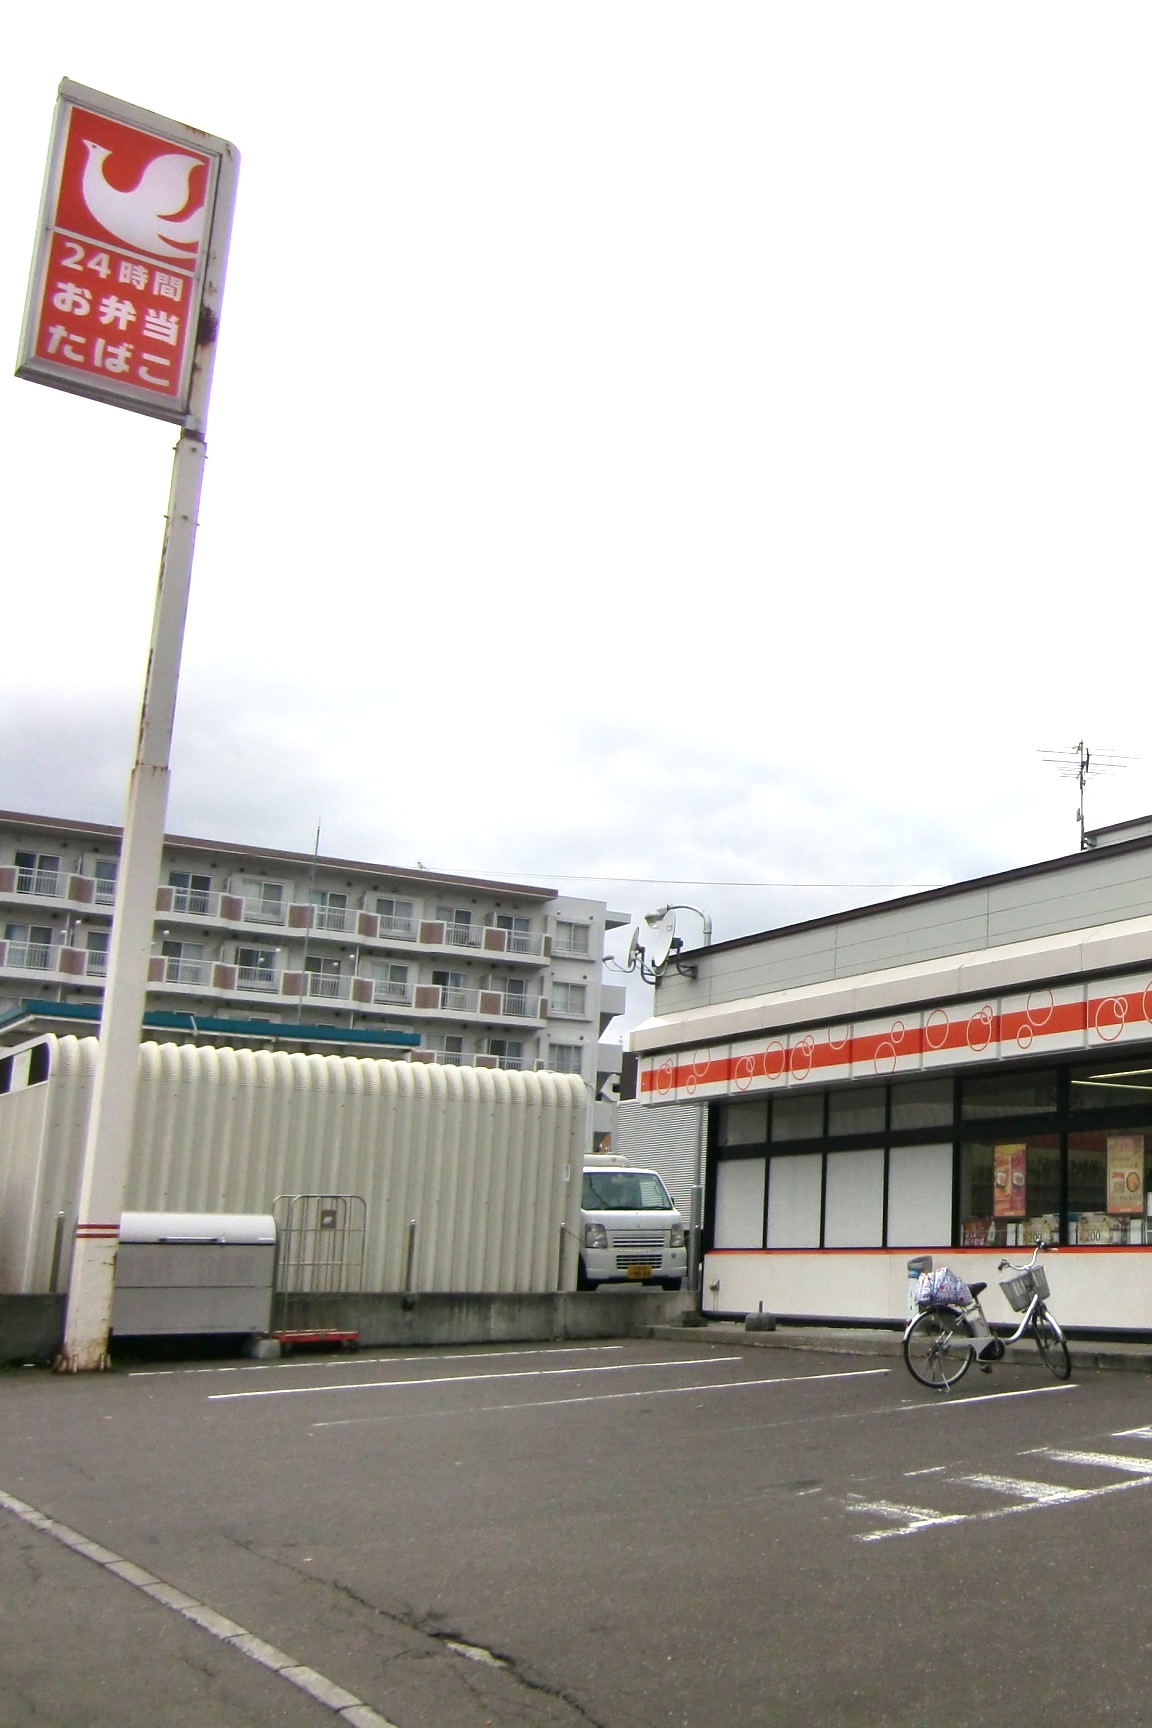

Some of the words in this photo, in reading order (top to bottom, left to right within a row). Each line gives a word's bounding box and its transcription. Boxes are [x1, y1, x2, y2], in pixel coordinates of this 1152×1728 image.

[60, 240, 183, 303] 24時間
[52, 281, 180, 347] お弁当
[46, 324, 171, 388] たばこ
